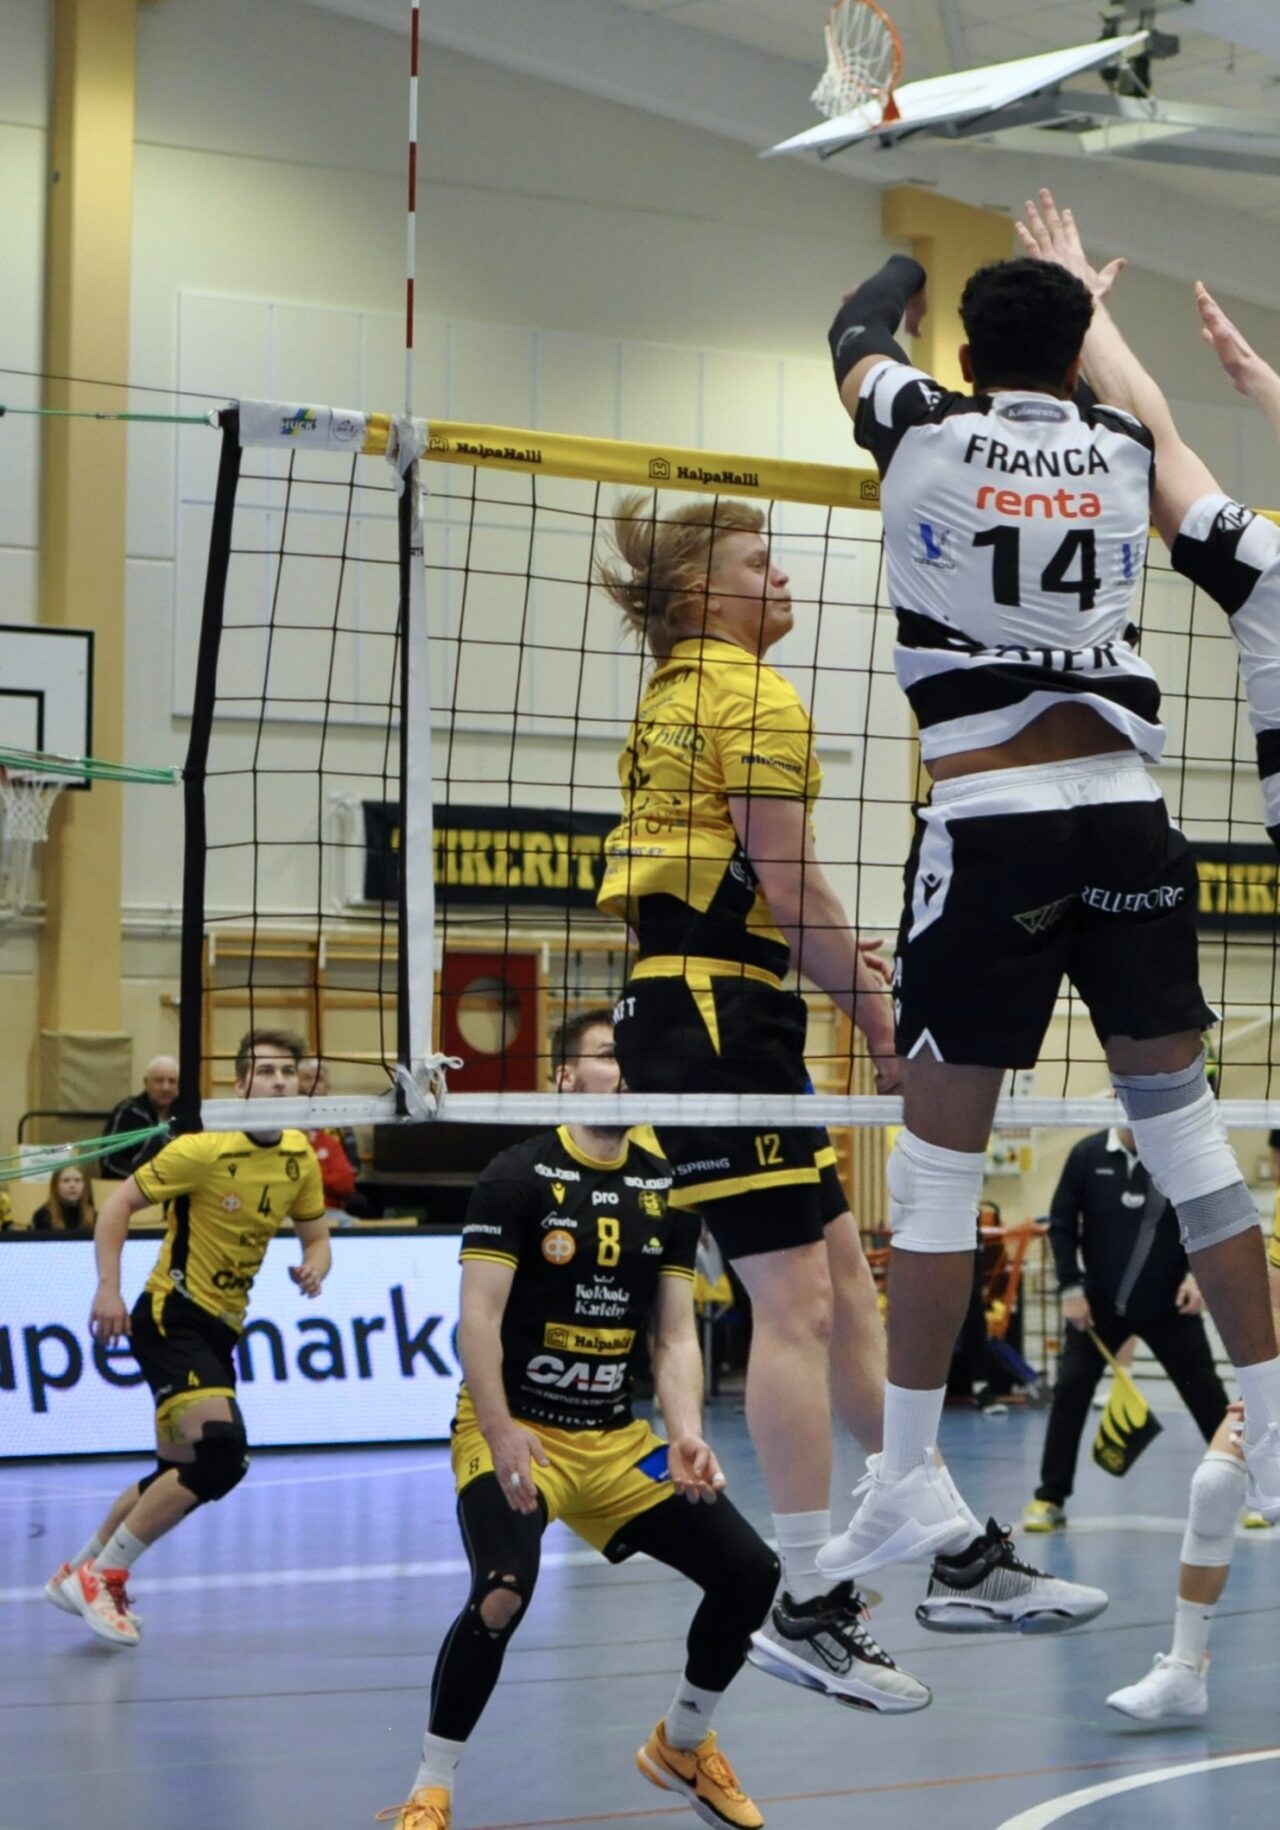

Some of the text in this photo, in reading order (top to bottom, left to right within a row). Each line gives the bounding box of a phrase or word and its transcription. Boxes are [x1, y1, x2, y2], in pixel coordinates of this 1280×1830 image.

[455, 442, 542, 463] HalpaHalli
[963, 433, 1110, 477] FRANCA
[677, 466, 760, 488] HalpaHalli
[975, 486, 1102, 519] renta
[971, 525, 1102, 612] 14
[391, 828, 602, 890] IKERIT
[754, 1133, 784, 1167] 12
[257, 1184, 272, 1217] 4
[591, 1190, 620, 1207] pro
[596, 1216, 622, 1268] 8
[468, 1457, 480, 1476] 8
